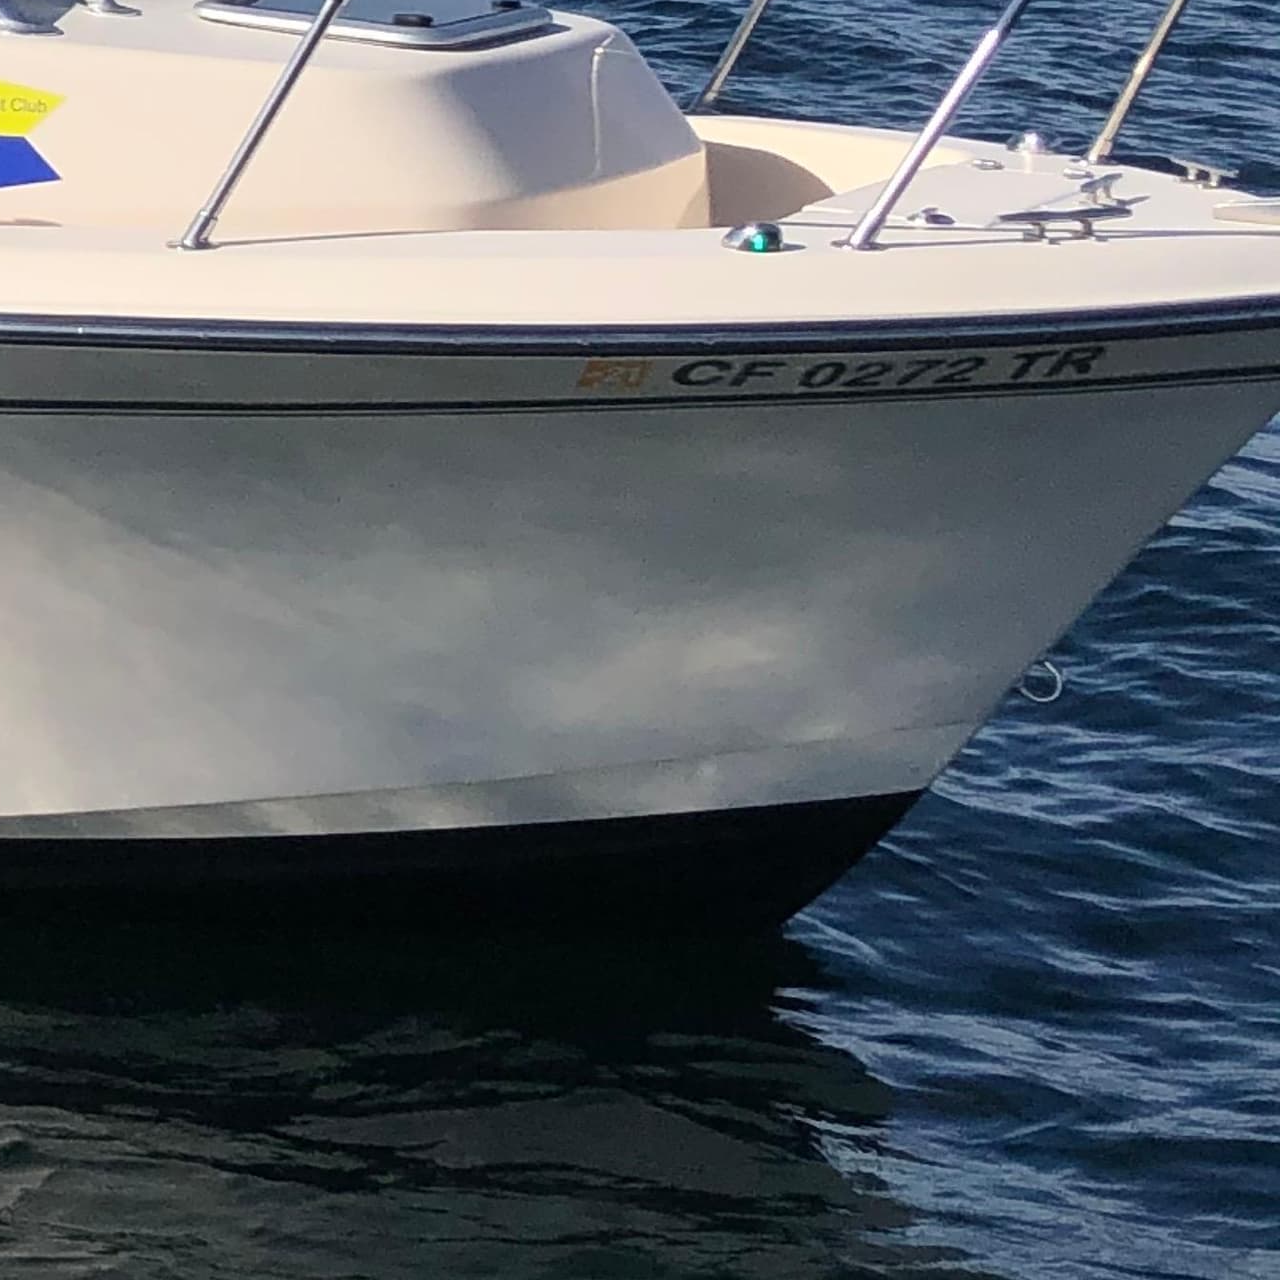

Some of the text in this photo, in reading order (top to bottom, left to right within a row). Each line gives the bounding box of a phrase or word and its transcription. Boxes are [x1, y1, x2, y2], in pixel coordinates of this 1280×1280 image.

[10, 98, 48, 113] Club
[671, 359, 788, 387] CF
[798, 356, 986, 388] 0272
[1009, 345, 1106, 380] TR
